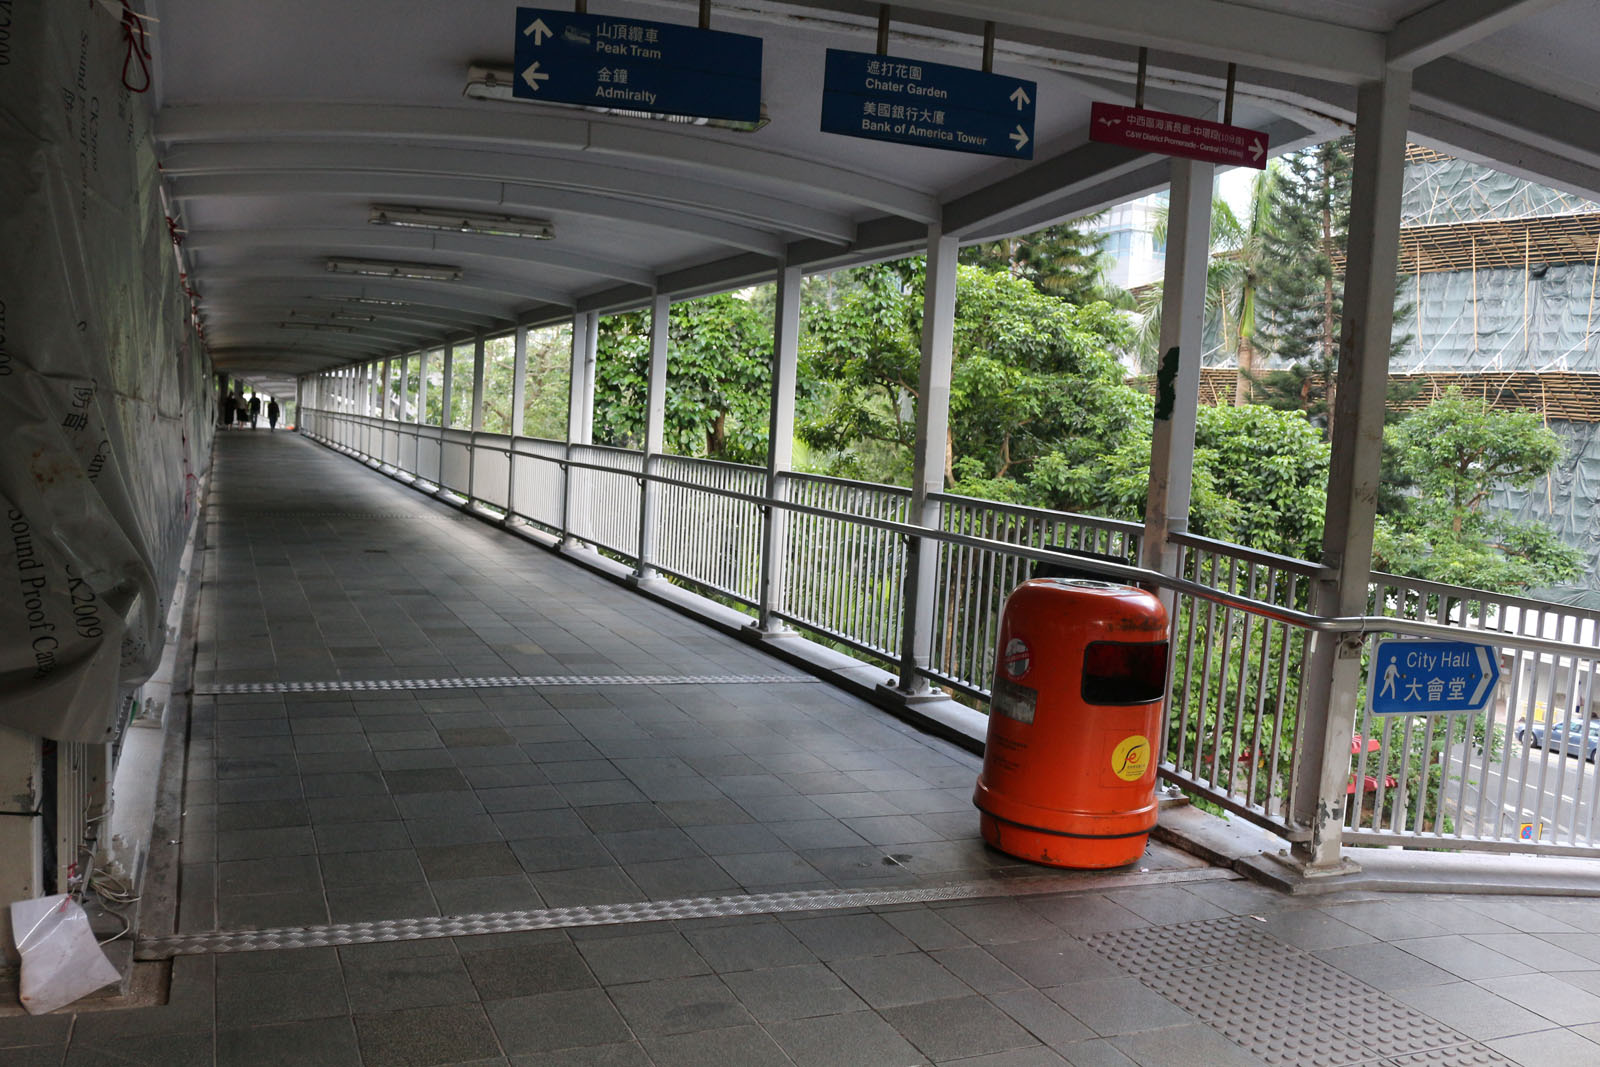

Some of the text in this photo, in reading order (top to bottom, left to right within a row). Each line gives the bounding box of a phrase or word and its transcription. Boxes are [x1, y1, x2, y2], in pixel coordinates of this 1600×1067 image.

[596, 23, 659, 43] 山頂纜車
[596, 41, 662, 60] Peak Tram
[597, 67, 629, 85] 金鐘
[866, 60, 923, 81] 遮打花園
[595, 85, 657, 104] Admiralty
[865, 77, 948, 99] Chater Garden
[863, 101, 946, 125] 美國銀行大廈
[861, 118, 988, 146] Bank of America Tower
[1142, 132, 1164, 143] District
[61, 386, 94, 432] 防音
[19, 576, 56, 632] Proof
[65, 563, 105, 639] K2009
[1406, 651, 1470, 672] City Hall
[1403, 676, 1466, 702] 大會堂
